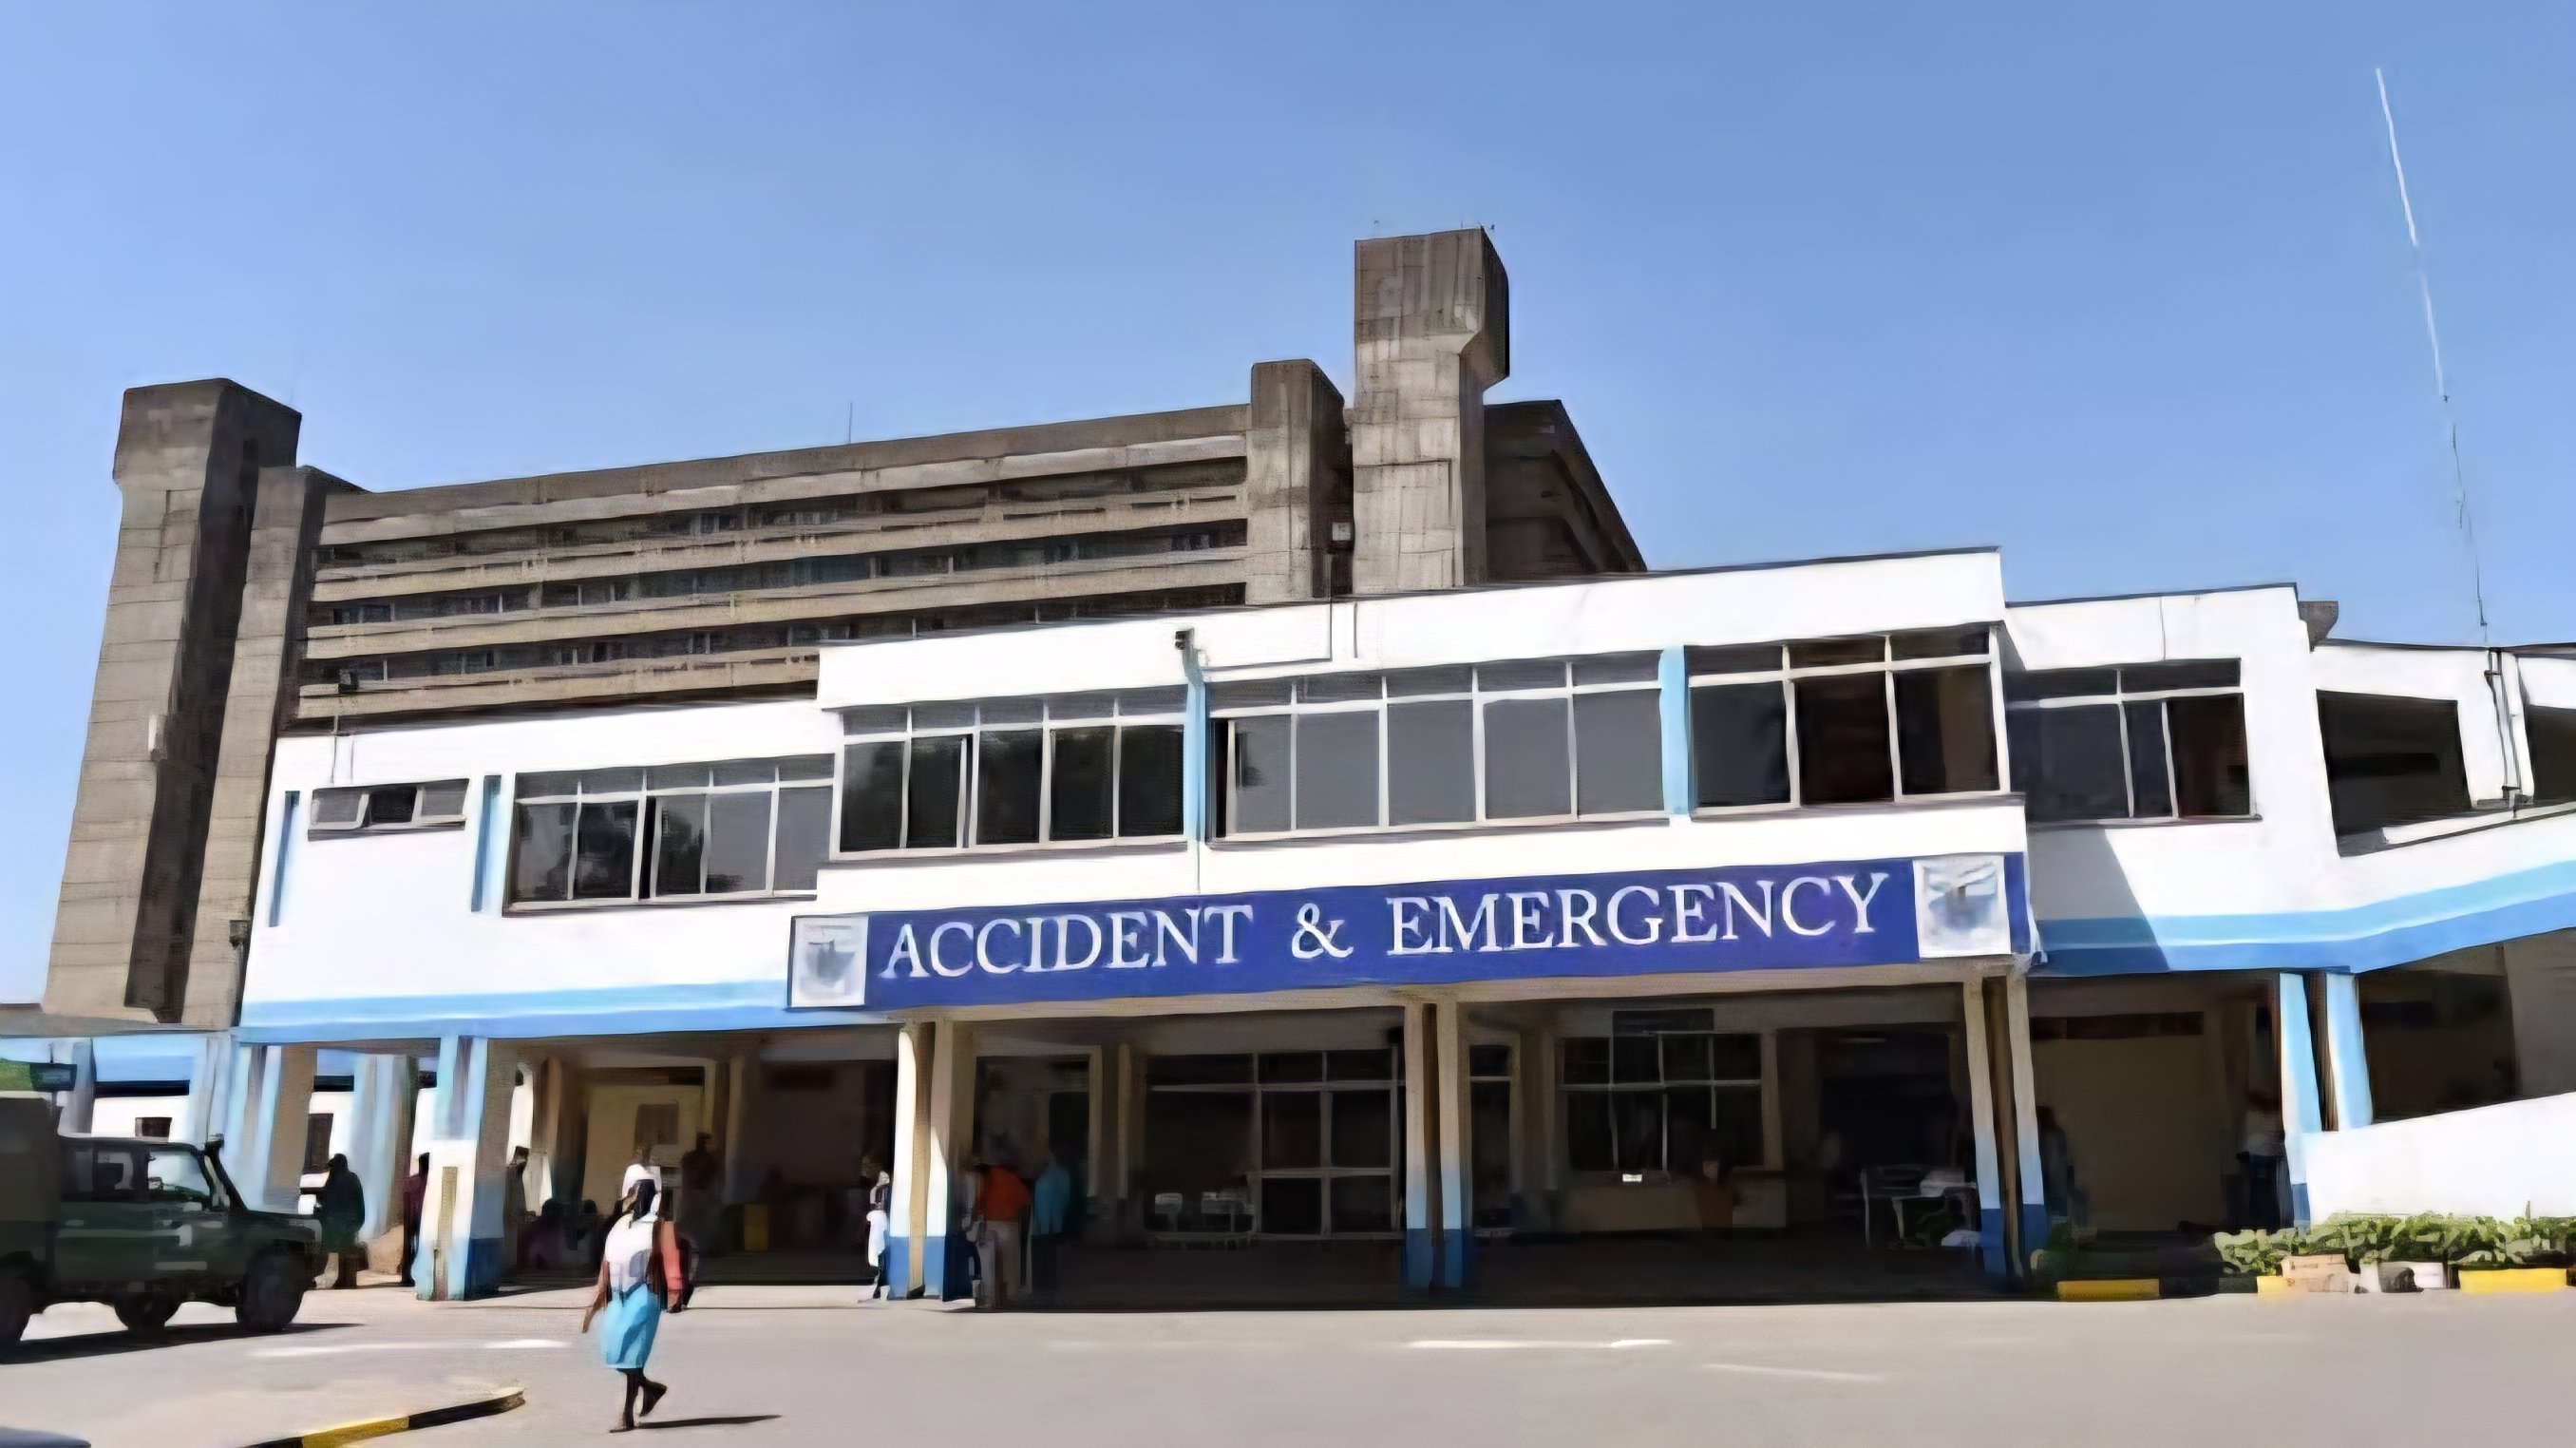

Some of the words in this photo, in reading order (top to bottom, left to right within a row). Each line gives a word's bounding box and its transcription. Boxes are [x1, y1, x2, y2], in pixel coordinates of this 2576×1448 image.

[880, 903, 1254, 980] ACCIDENT
[1290, 902, 1355, 961] &
[1385, 871, 1890, 957] EMERGENCY
